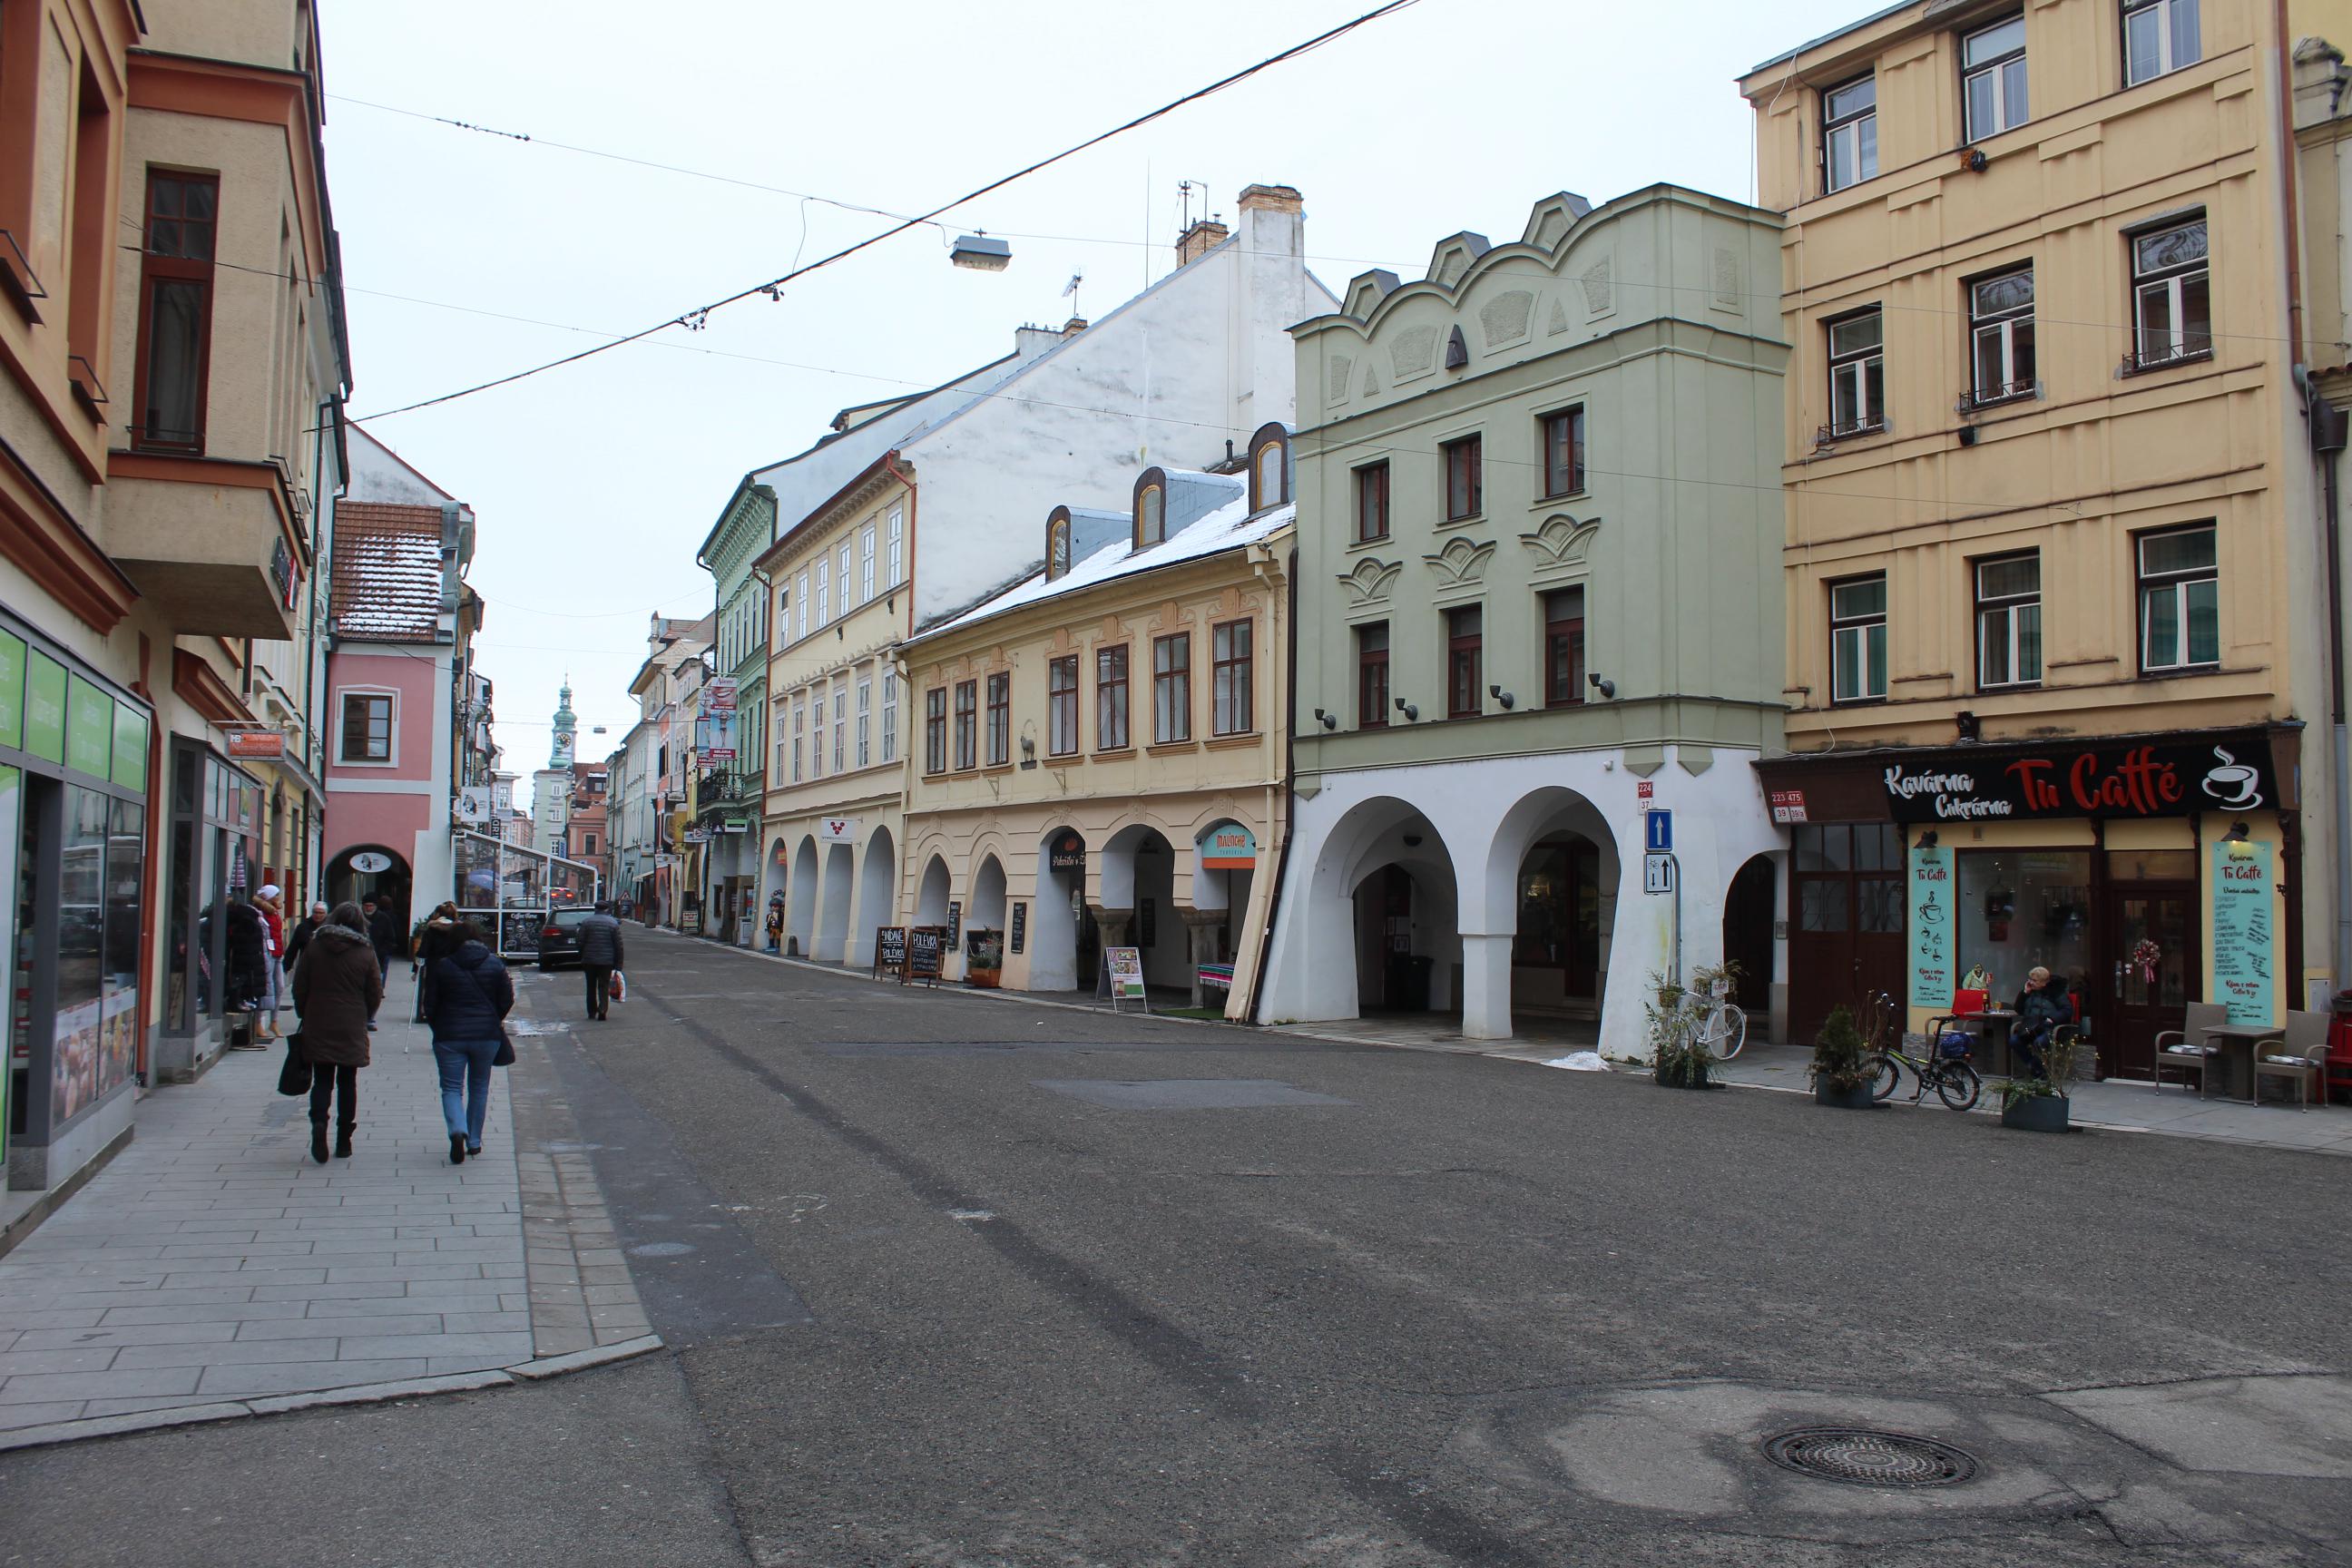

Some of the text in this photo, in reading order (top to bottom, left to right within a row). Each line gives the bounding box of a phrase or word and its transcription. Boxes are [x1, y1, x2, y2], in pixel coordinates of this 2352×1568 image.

[1884, 765, 1975, 799] Kavárna
[2004, 746, 2184, 814] Tu Caffé
[1638, 783, 1651, 792] 224
[1772, 793, 1801, 802] 223 475
[1641, 801, 1650, 809] 37
[1936, 793, 2013, 819] Cukrárna
[1777, 808, 1805, 818] 39 39/a
[2221, 866, 2233, 879] Tu
